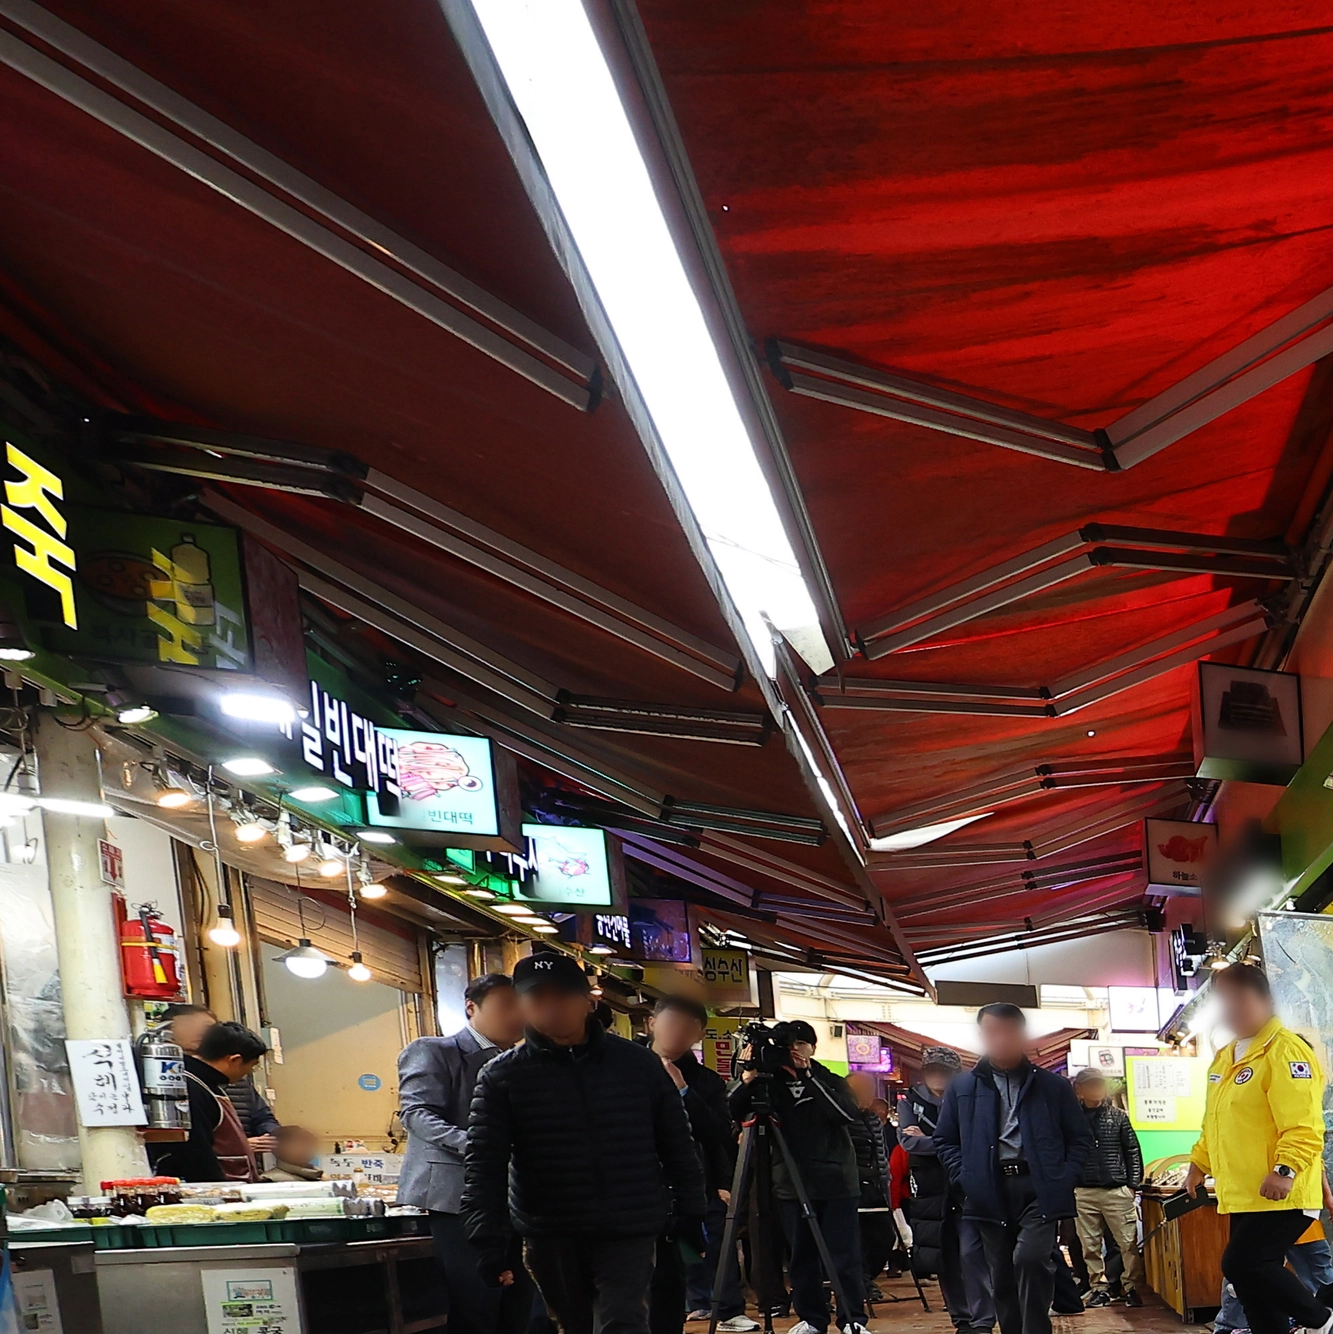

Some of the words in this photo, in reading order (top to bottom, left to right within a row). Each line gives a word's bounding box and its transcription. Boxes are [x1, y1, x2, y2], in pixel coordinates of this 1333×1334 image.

[424, 809, 473, 826] 빈대떡
[534, 960, 554, 970] NY
[702, 957, 744, 983] 싱수산
